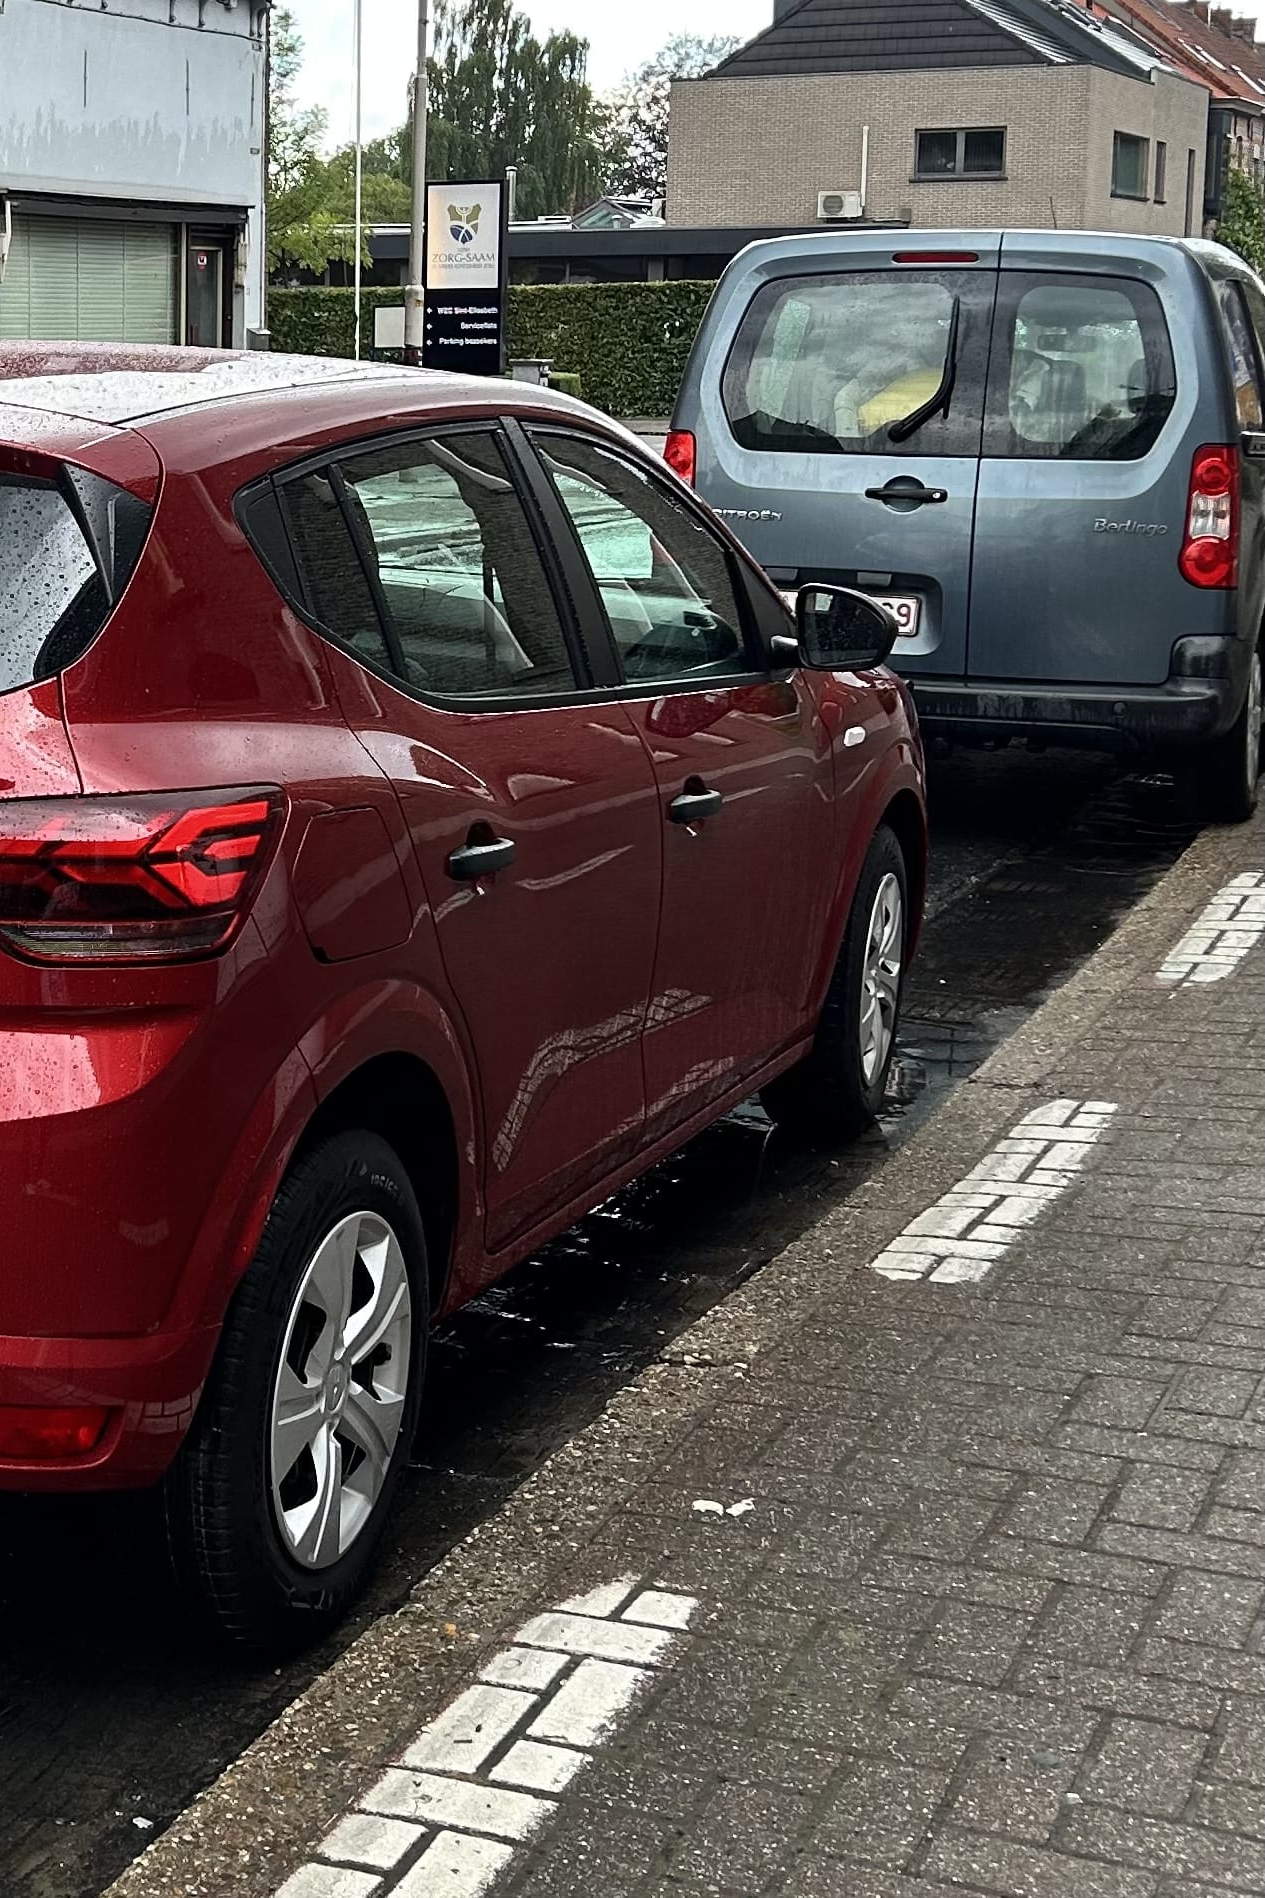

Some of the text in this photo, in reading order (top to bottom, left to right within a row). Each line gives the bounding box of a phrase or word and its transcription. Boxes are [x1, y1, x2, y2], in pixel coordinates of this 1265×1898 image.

[431, 253, 495, 262] ZORG-SAAM
[439, 338, 464, 346] Parking
[1093, 517, 1168, 537] Berlingo
